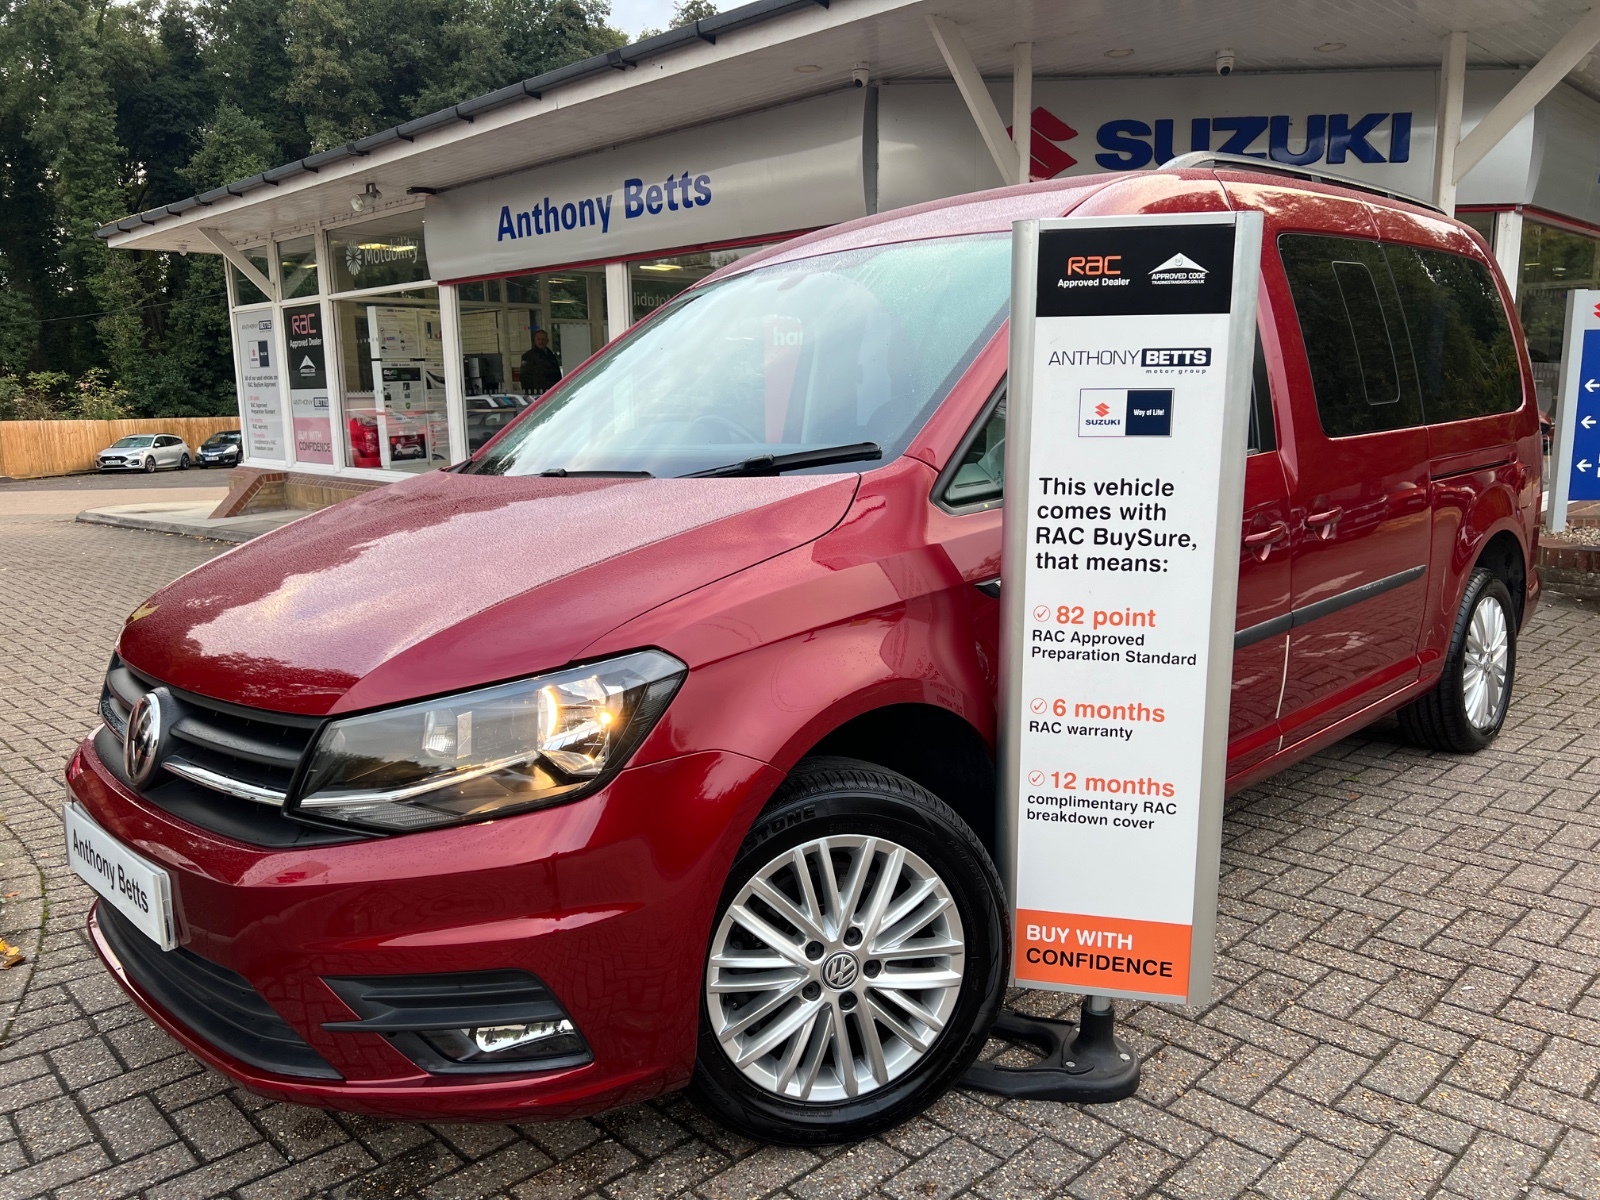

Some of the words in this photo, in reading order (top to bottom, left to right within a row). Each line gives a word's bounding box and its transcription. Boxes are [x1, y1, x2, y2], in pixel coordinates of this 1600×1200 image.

[1095, 112, 1412, 171] SUZUKI
[497, 193, 614, 242] Anthony
[623, 170, 712, 220] Betts
[1057, 278, 1099, 289] Approved
[1102, 277, 1131, 287] Dealer
[1151, 272, 1187, 280] APPROVED
[290, 338, 308, 349] Approved
[308, 337, 322, 346] Dealer
[1048, 350, 1140, 366] ANTHONY
[1145, 350, 1207, 365] BETTS
[1133, 409, 1145, 417] Way
[298, 441, 331, 452] CONFIDENCE
[1039, 477, 1086, 496] This
[1093, 478, 1175, 497] vehicle
[1037, 504, 1111, 520] comes
[1119, 503, 1167, 521] with
[1035, 527, 1084, 545] RAC
[1093, 528, 1197, 551] BuySure,
[1035, 552, 1079, 570] that
[1086, 556, 1168, 573] means:
[1056, 605, 1085, 625] 82
[1093, 607, 1157, 630] point
[1032, 630, 1065, 643] RAC
[1070, 631, 1145, 647] Approved
[1031, 646, 1120, 662] Preparation
[1125, 650, 1197, 666] Standard
[1052, 698, 1067, 717] 6
[1074, 702, 1166, 723] months
[1029, 721, 1062, 734] RAC
[1067, 724, 1133, 741] warranty
[1050, 771, 1077, 790] 12
[1085, 775, 1175, 797] months
[1027, 794, 1138, 814] complimentary
[1143, 802, 1177, 815] RAC
[1026, 808, 1109, 826] breakdown
[1112, 816, 1155, 830] cover
[73, 828, 115, 890] Anthony
[117, 863, 149, 914] Betts
[1026, 924, 1070, 943] BUY
[1075, 929, 1133, 951] WITH
[1026, 947, 1173, 978] CONFIDENCE
